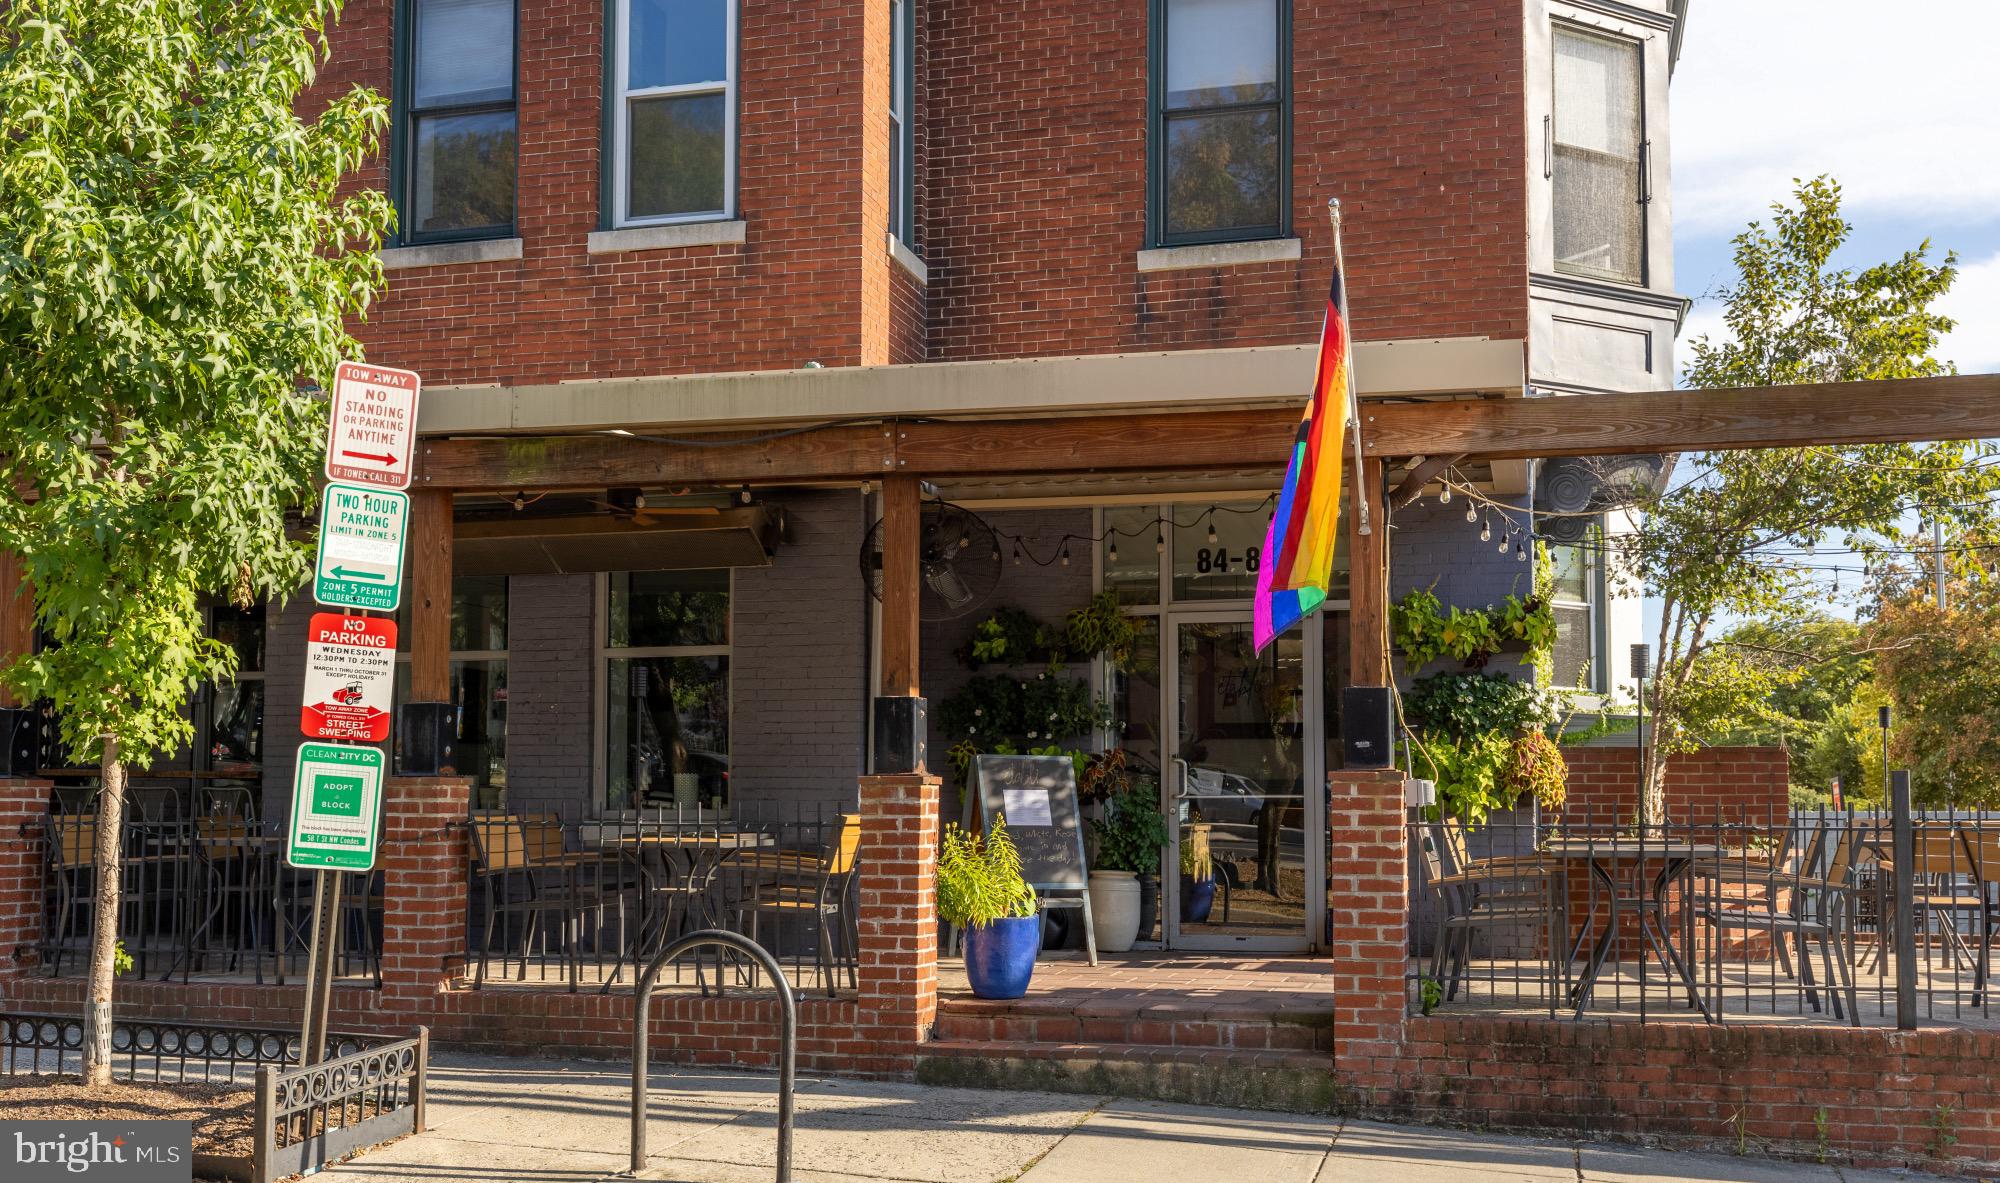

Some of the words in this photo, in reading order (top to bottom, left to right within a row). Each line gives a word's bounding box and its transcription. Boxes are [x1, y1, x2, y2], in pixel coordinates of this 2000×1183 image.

[345, 368, 370, 380] TOW
[374, 372, 408, 386] AWAY
[366, 389, 387, 402] NO
[346, 401, 404, 419] STANDING
[344, 415, 356, 424] OR
[360, 416, 404, 432] PARKING
[348, 428, 396, 445] ANYTIME
[334, 467, 341, 476] IF
[344, 468, 368, 480] TOWED
[370, 472, 388, 482] CALL
[390, 476, 401, 484] 311
[336, 493, 359, 509] TWO
[365, 498, 398, 515] HOUR
[341, 512, 389, 528] PARKING
[330, 526, 352, 534] LIMIT
[368, 530, 388, 539] ZONE
[392, 533, 397, 541] 5
[322, 582, 347, 592] ZONE
[350, 584, 358, 594] 5
[360, 586, 392, 597] PERMIT
[322, 592, 354, 602] HOLDERS
[356, 596, 392, 607] EXCEPTED
[343, 619, 366, 632] NO
[320, 630, 386, 647] PARKING
[322, 646, 382, 657] WEDNESDAY
[313, 654, 345, 663] 12:30PM
[360, 658, 389, 666] 2:30PM
[326, 719, 365, 729] STREET
[306, 749, 337, 759] CLEAN
[338, 752, 361, 761] CITY
[362, 753, 376, 762] DC
[323, 783, 354, 791] ADOPT
